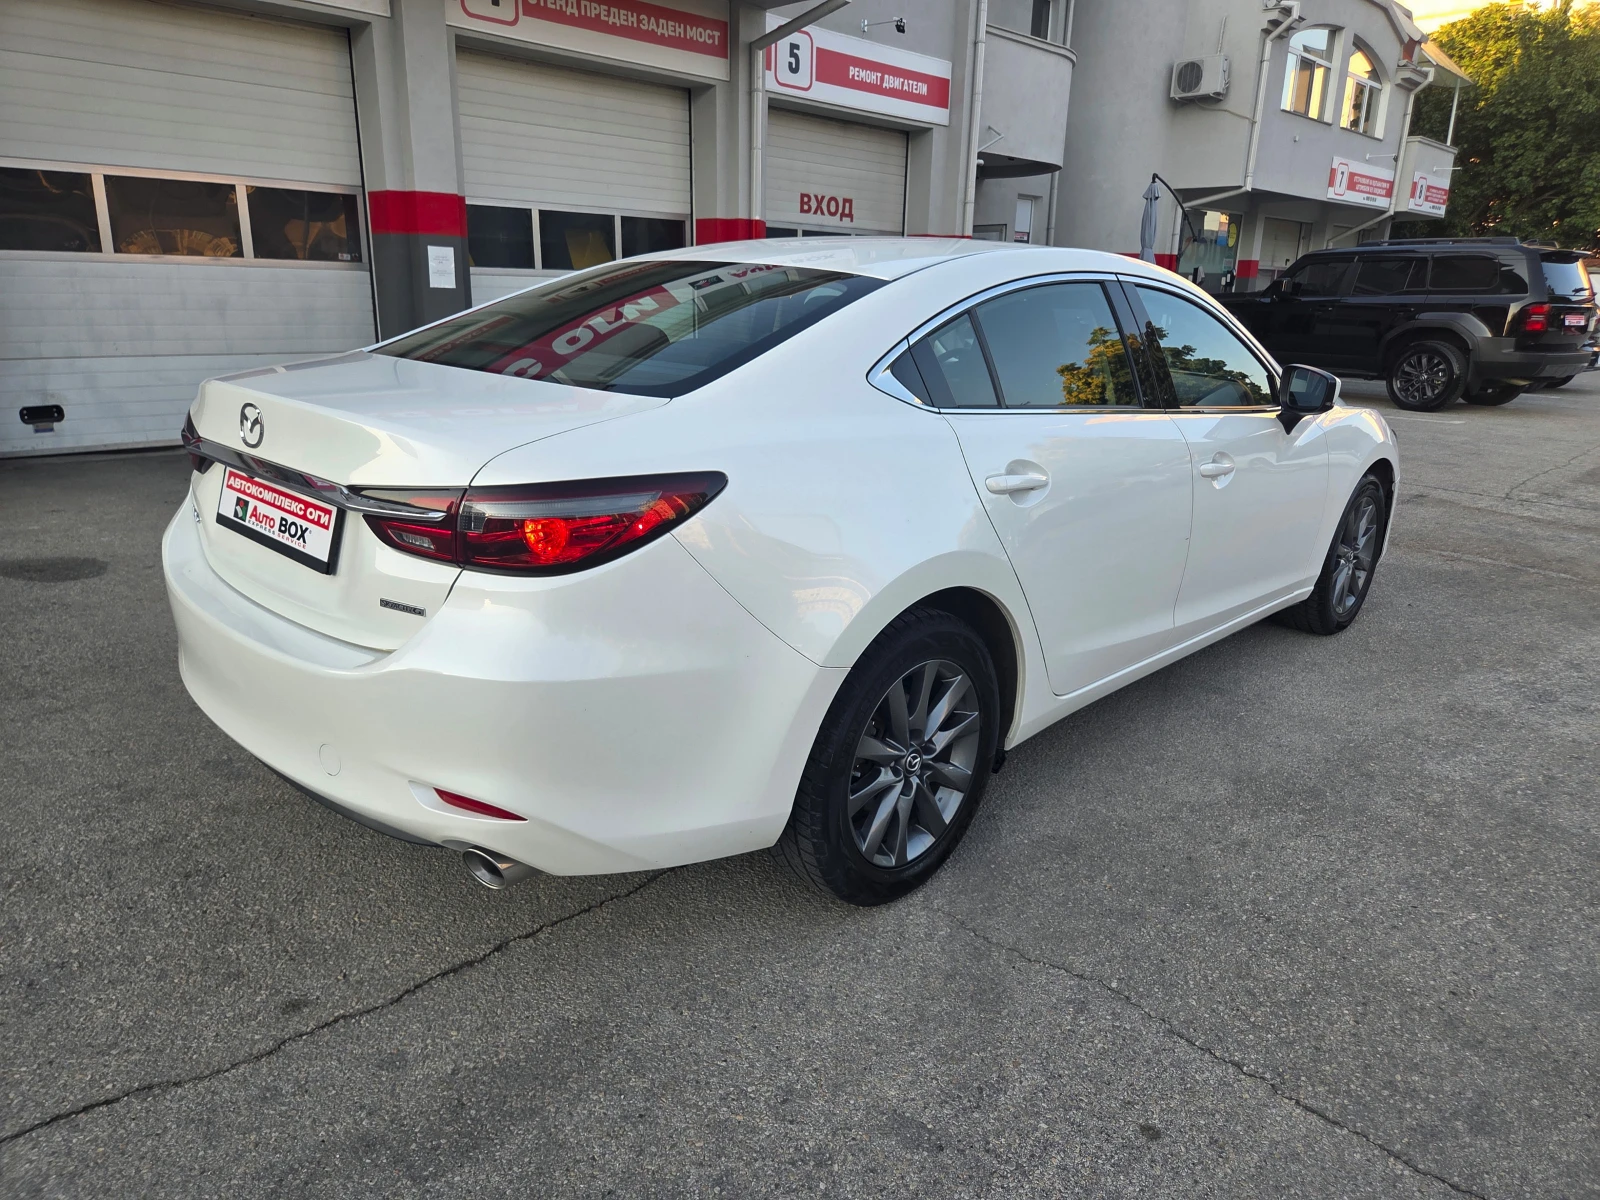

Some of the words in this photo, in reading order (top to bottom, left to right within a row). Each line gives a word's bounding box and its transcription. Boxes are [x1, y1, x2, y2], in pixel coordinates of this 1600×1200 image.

[527, 0, 579, 17] ЕНД
[580, 4, 638, 29] ПРЕДЕН
[639, 14, 685, 38] ЗАДЕН
[686, 26, 721, 46] МОСТ
[787, 42, 801, 75] 5
[849, 65, 882, 87] РЕМОНТ
[882, 73, 928, 96] ДВИГАТЕЛИ
[1339, 170, 1345, 188] 7
[799, 192, 854, 223] ВХОД
[227, 475, 305, 515] АВТОКОМПЛЕКС
[306, 507, 330, 526] ОГИ
[247, 519, 276, 536] EXPRESS
[277, 532, 306, 550] SERVICE
